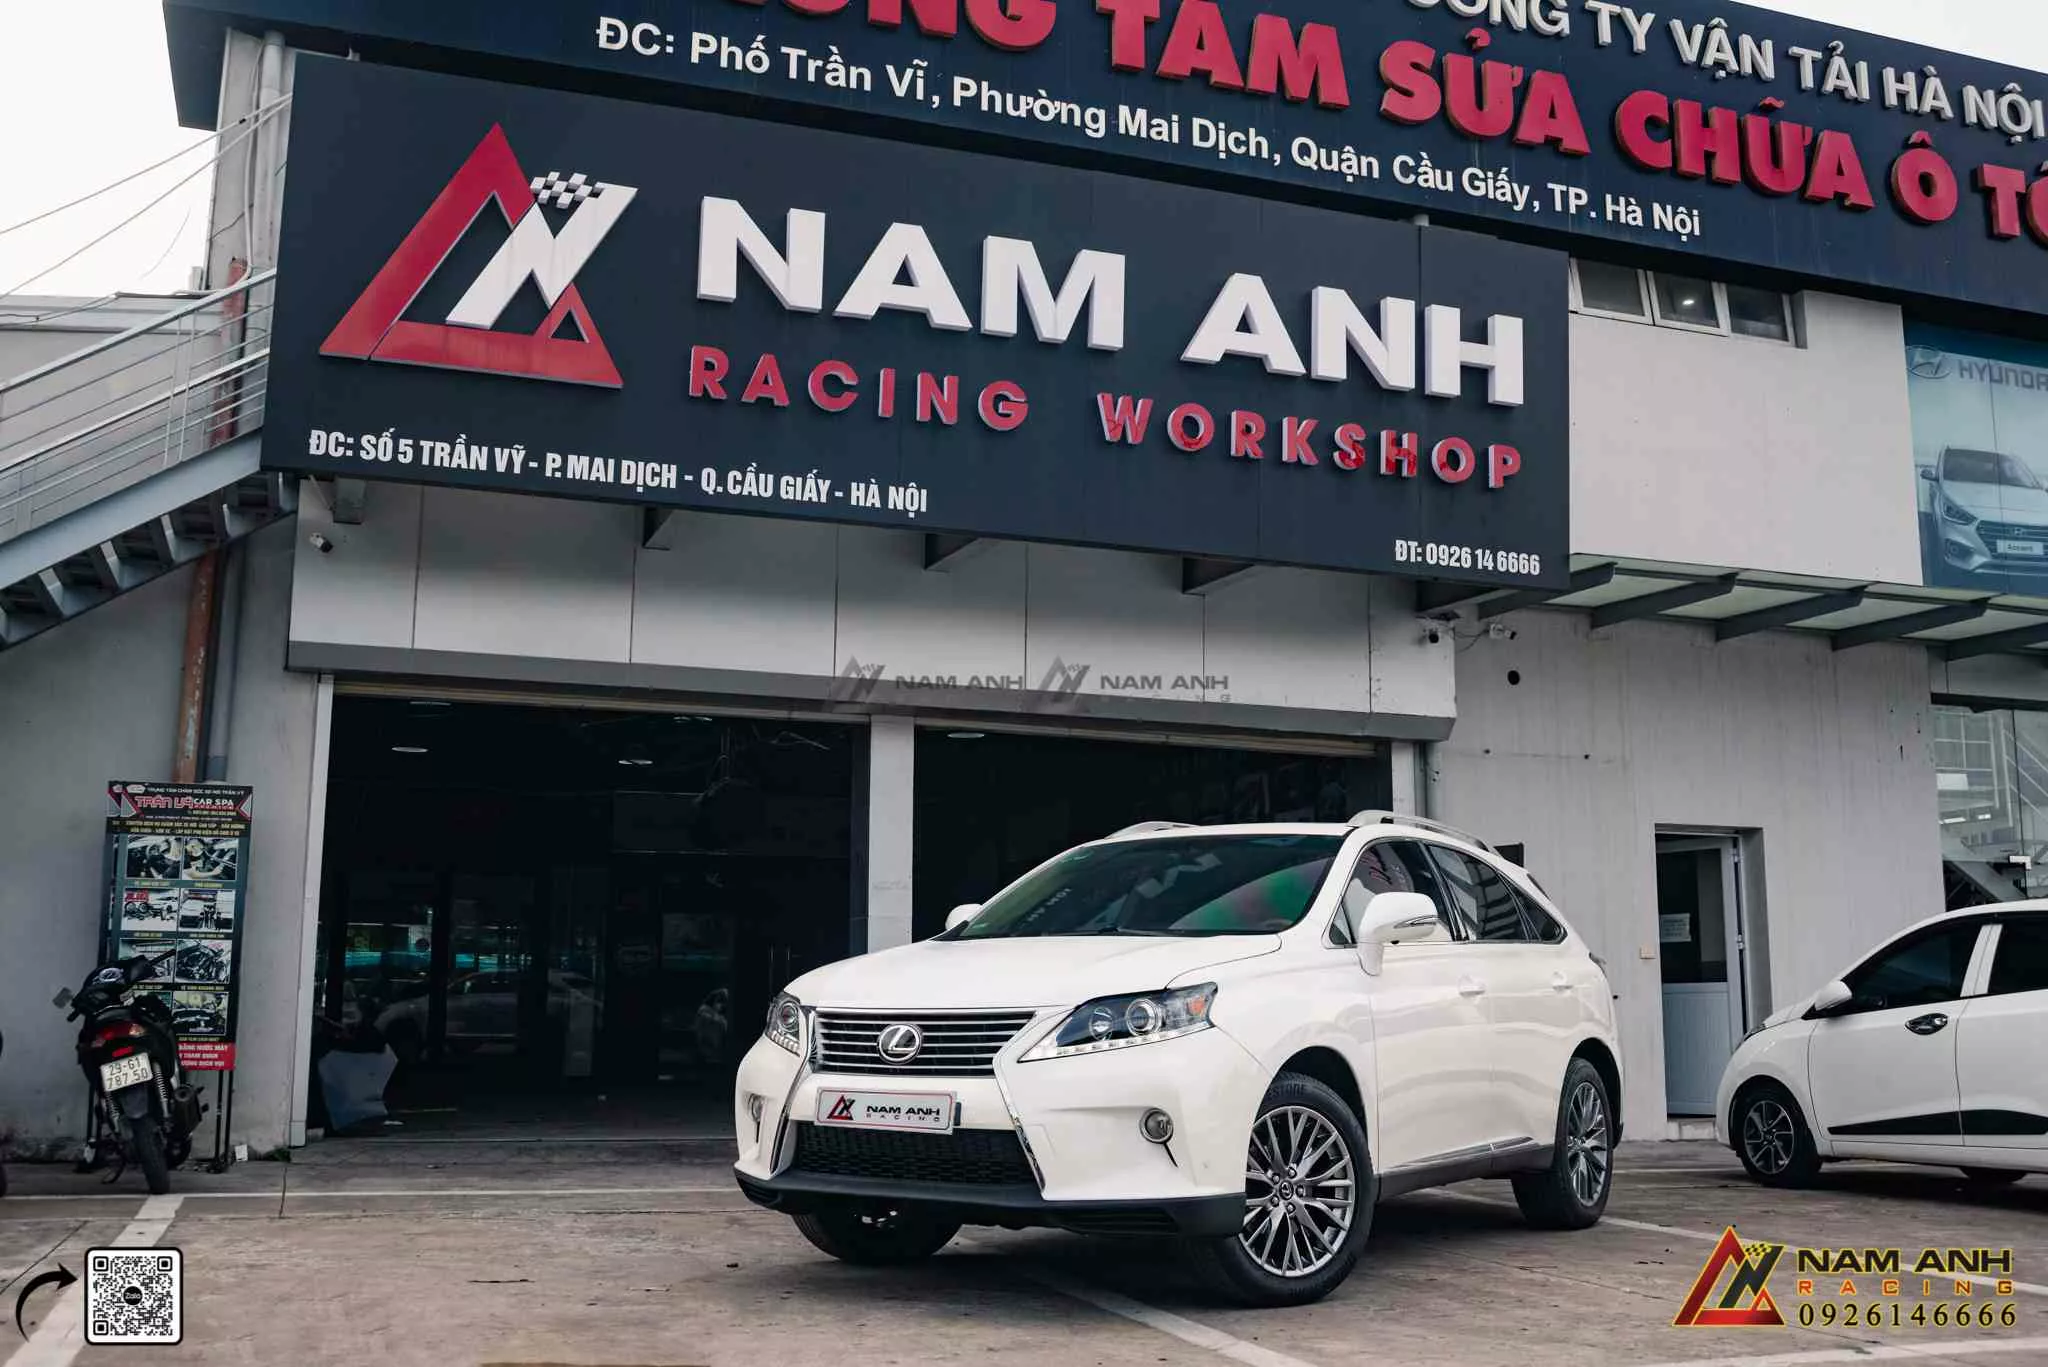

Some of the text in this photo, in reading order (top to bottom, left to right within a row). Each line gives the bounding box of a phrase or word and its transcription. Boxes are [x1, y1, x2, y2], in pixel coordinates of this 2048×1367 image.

[596, 16, 674, 56] ĐC:
[690, 31, 770, 75] Phố
[780, 45, 872, 92] Trần
[953, 75, 1106, 138] Phường
[1118, 105, 1180, 145] Mai
[1192, 116, 1281, 167] Dịch,
[1291, 136, 1379, 184] Quận
[1392, 151, 1453, 193] Cầu
[1461, 166, 1540, 213] Giấy,
[1547, 182, 1597, 219] TP.
[1605, 193, 1643, 227] Hà
[1652, 201, 1701, 242] Nội
[1379, 27, 1592, 156] SỬA
[1614, 90, 1876, 213] CHỮA
[1891, 130, 1959, 225] Ô
[1584, 0, 1656, 53] TY
[1669, 17, 1775, 81] VẬN
[1788, 40, 1871, 102] TẢI
[1882, 64, 1954, 120] HÀ
[1962, 82, 2045, 144] NỘI
[696, 195, 1524, 407] NAM ANH
[308, 429, 354, 457] ĐC:
[359, 427, 397, 463] SỐ
[398, 438, 413, 464] 5
[419, 434, 488, 471] TRẦN
[494, 444, 526, 474] VỸ
[621, 459, 677, 493] DỊCH
[780, 469, 831, 503] GIẤY
[850, 478, 881, 509] HÀ
[888, 482, 928, 518] NỘI
[688, 344, 1522, 489] RACING WORKSHOP
[1395, 539, 1541, 576] ĐT: 0926 14 6666
[866, 1105, 940, 1116] NAM ANH
